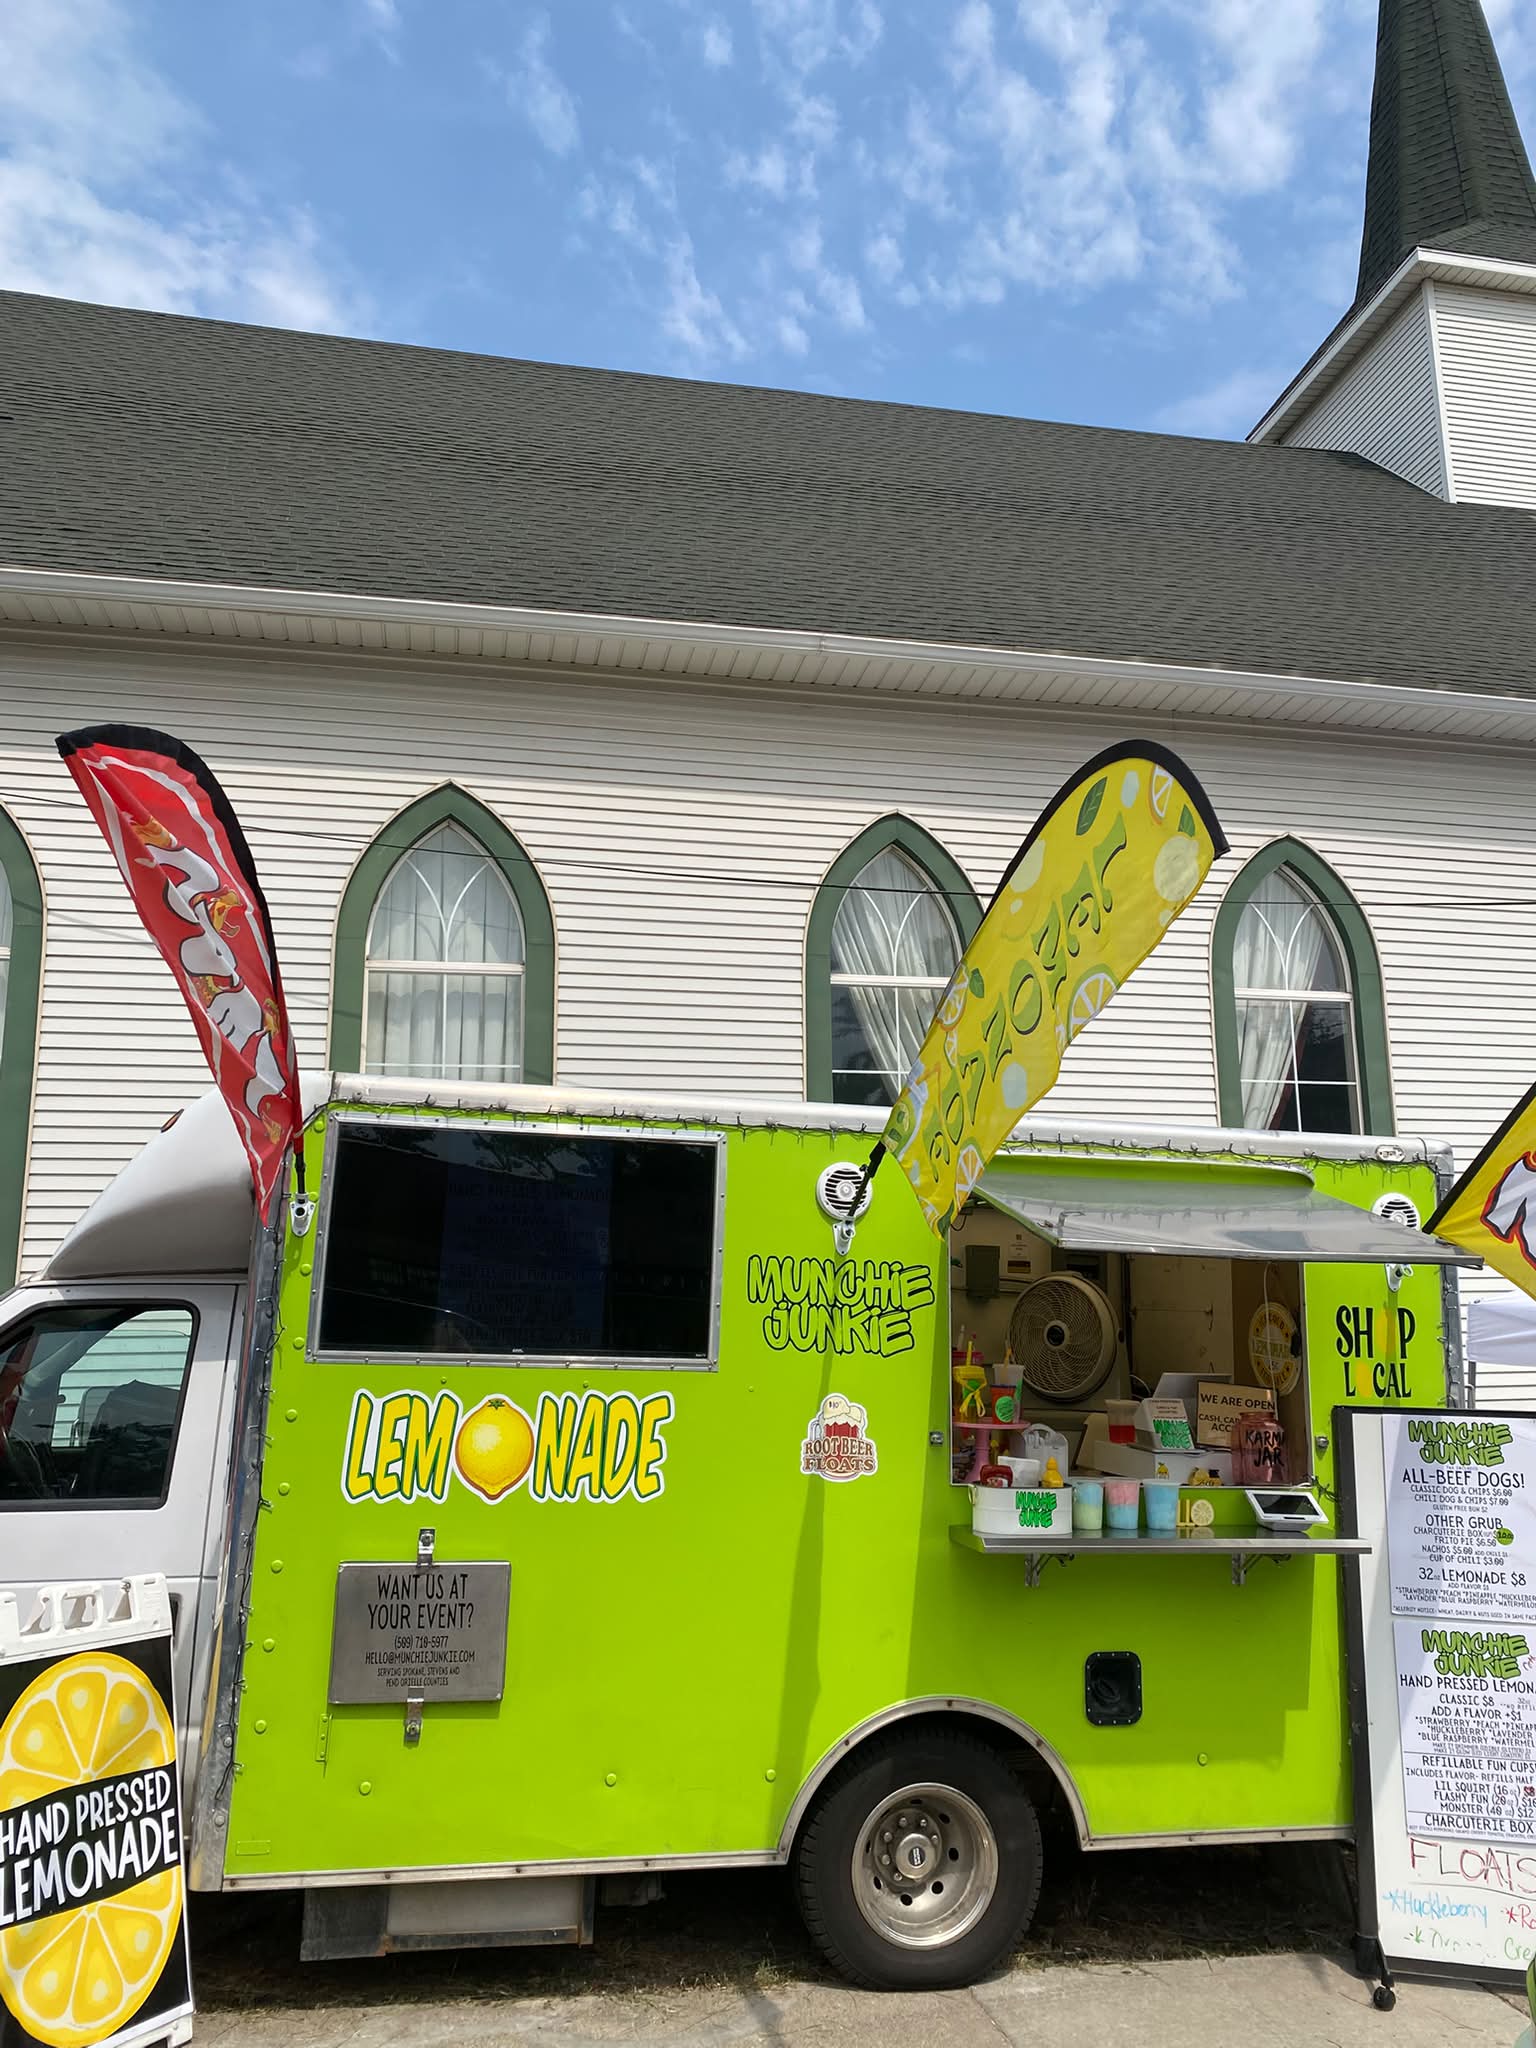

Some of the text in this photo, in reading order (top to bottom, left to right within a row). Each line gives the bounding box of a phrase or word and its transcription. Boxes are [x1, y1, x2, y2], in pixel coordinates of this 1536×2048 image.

[1200, 1393, 1275, 1410] WE ARE OPEN
[805, 1437, 872, 1455] ROOT BEER
[805, 1457, 874, 1471] FLOATS
[1254, 1447, 1284, 1467] JAR
[1402, 1468, 1525, 1488] ALL-BEEF DOGS!
[1410, 1484, 1441, 1494] CLASSIC
[1442, 1485, 1459, 1495] DOG
[1468, 1487, 1490, 1496] CHIPS
[1414, 1494, 1437, 1503] CHILI
[1440, 1495, 1455, 1504] DOG
[1465, 1496, 1487, 1505] CHIPS
[1425, 1514, 1503, 1530] OTHER GRUB
[1413, 1526, 1465, 1537] CHARCUTERIE
[1467, 1529, 1483, 1538] BOX
[1434, 1536, 1459, 1545] FRITO
[1461, 1537, 1474, 1546] PIE
[1422, 1545, 1451, 1554] NACHOS
[1429, 1554, 1444, 1562] CUP
[1445, 1555, 1455, 1563] OF
[1457, 1555, 1480, 1565] CHILI
[1441, 1568, 1507, 1585] LEMONADE
[1511, 1571, 1527, 1587] $8
[377, 1573, 469, 1601] WANT US AT
[368, 1602, 474, 1630] YOUR EVENT?
[365, 1650, 475, 1664] HELLO@MUNCHIEJUNKIE.COM
[1400, 1674, 1536, 1694] HAND PRESSED LEMON
[1439, 1693, 1480, 1706] CLASSIC
[1482, 1696, 1495, 1707] $8
[1431, 1706, 1452, 1717] ADD
[1454, 1707, 1461, 1717] A
[1464, 1707, 1502, 1720] FLAVOR
[1443, 1734, 1488, 1744] RASPBERRY
[1422, 1755, 1485, 1770] REFILLABLE
[1487, 1760, 1507, 1771] FUN
[1406, 1768, 1443, 1778] INCLUDES
[1481, 1773, 1514, 1784] REFILLS
[1515, 1776, 1534, 1785] HALF
[1435, 1780, 1451, 1791] LIL
[1455, 1782, 1490, 1794] SQUIRT
[1434, 1790, 1467, 1802] FLASHY
[1471, 1793, 1489, 1805] FUN
[0, 1769, 171, 1862] HAND PRESSED
[1440, 1802, 1484, 1815] MONSTER
[1517, 1807, 1534, 1819] $12
[1425, 1814, 1506, 1832] CHARCUTERIE
[1510, 1821, 1534, 1834] BOX
[0, 1807, 179, 1926] LEMONADE
